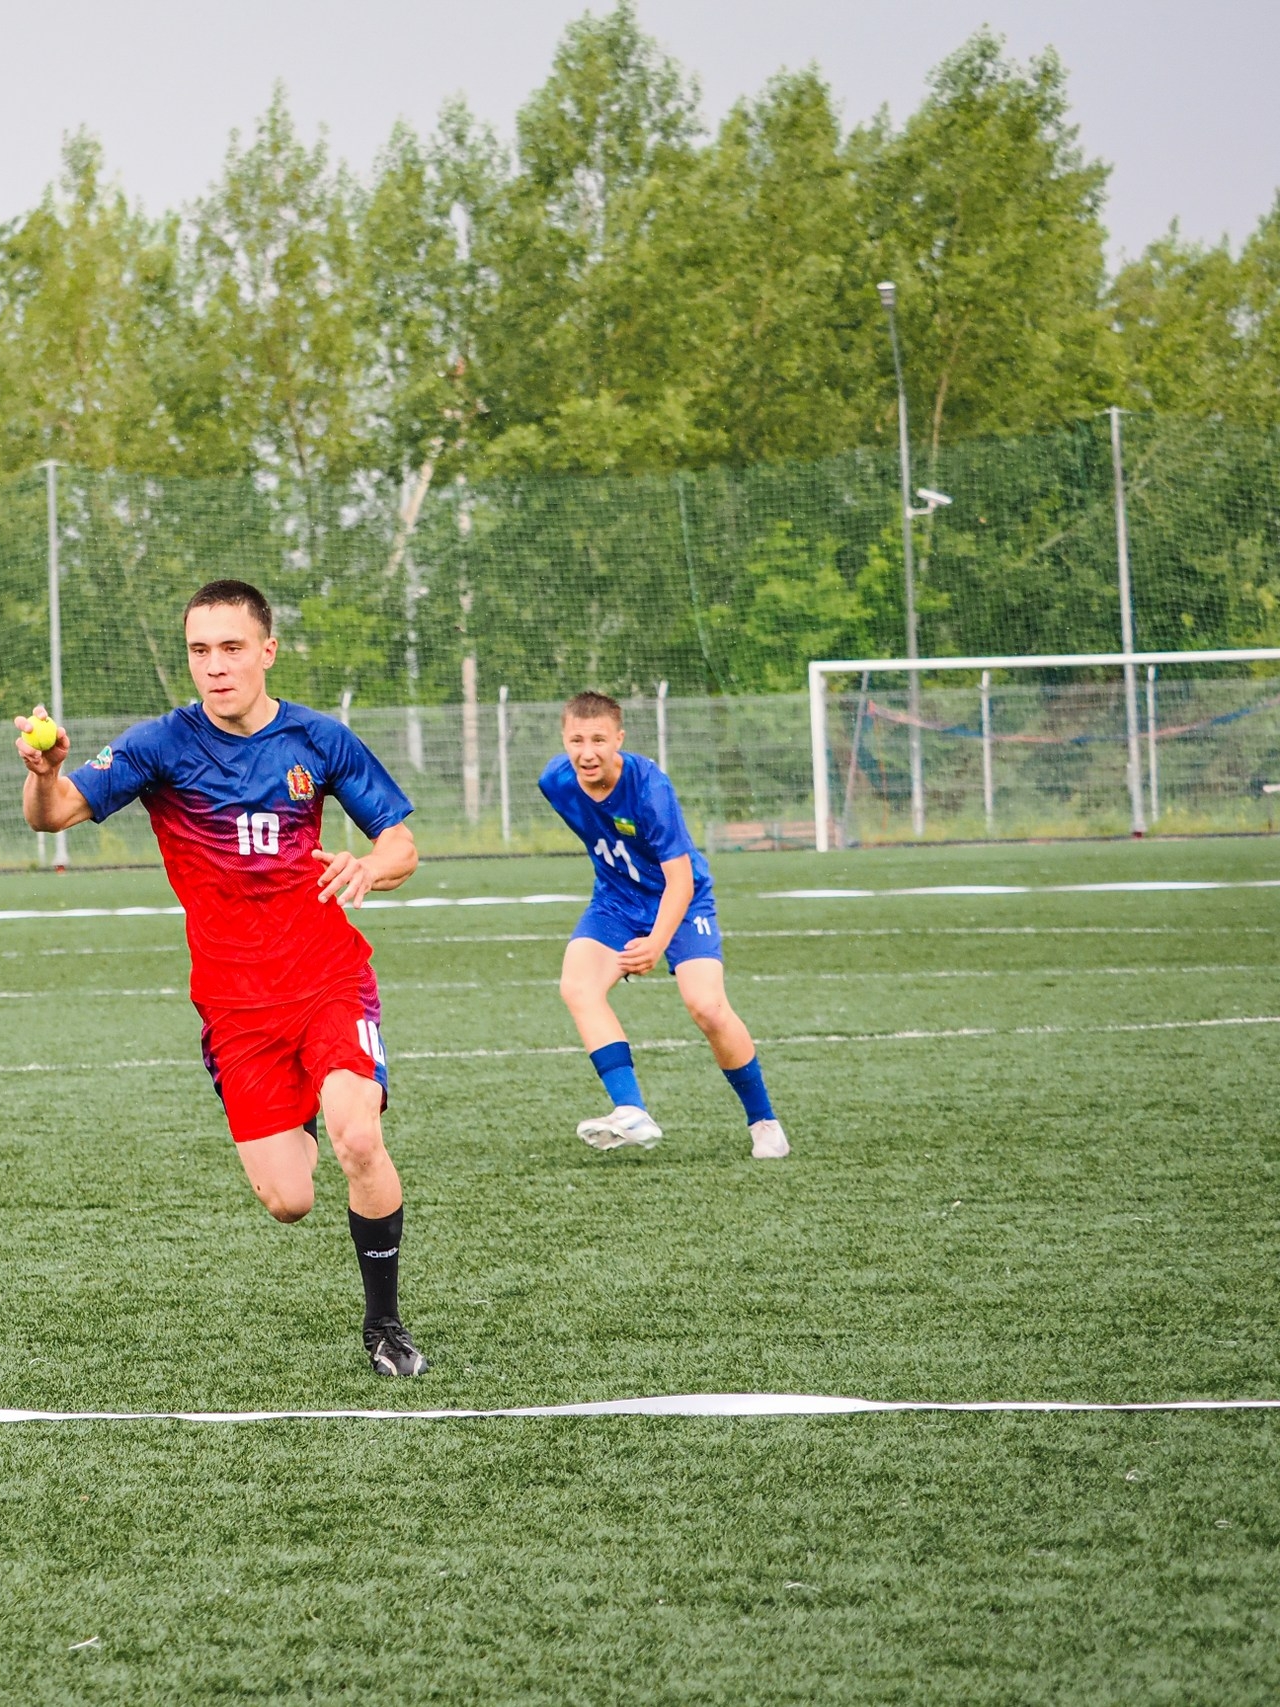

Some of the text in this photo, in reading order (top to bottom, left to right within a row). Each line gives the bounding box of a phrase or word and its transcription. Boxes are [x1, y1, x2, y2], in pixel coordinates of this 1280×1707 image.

[236, 812, 280, 856] 10
[594, 838, 640, 883] 11
[693, 916, 711, 936] 11
